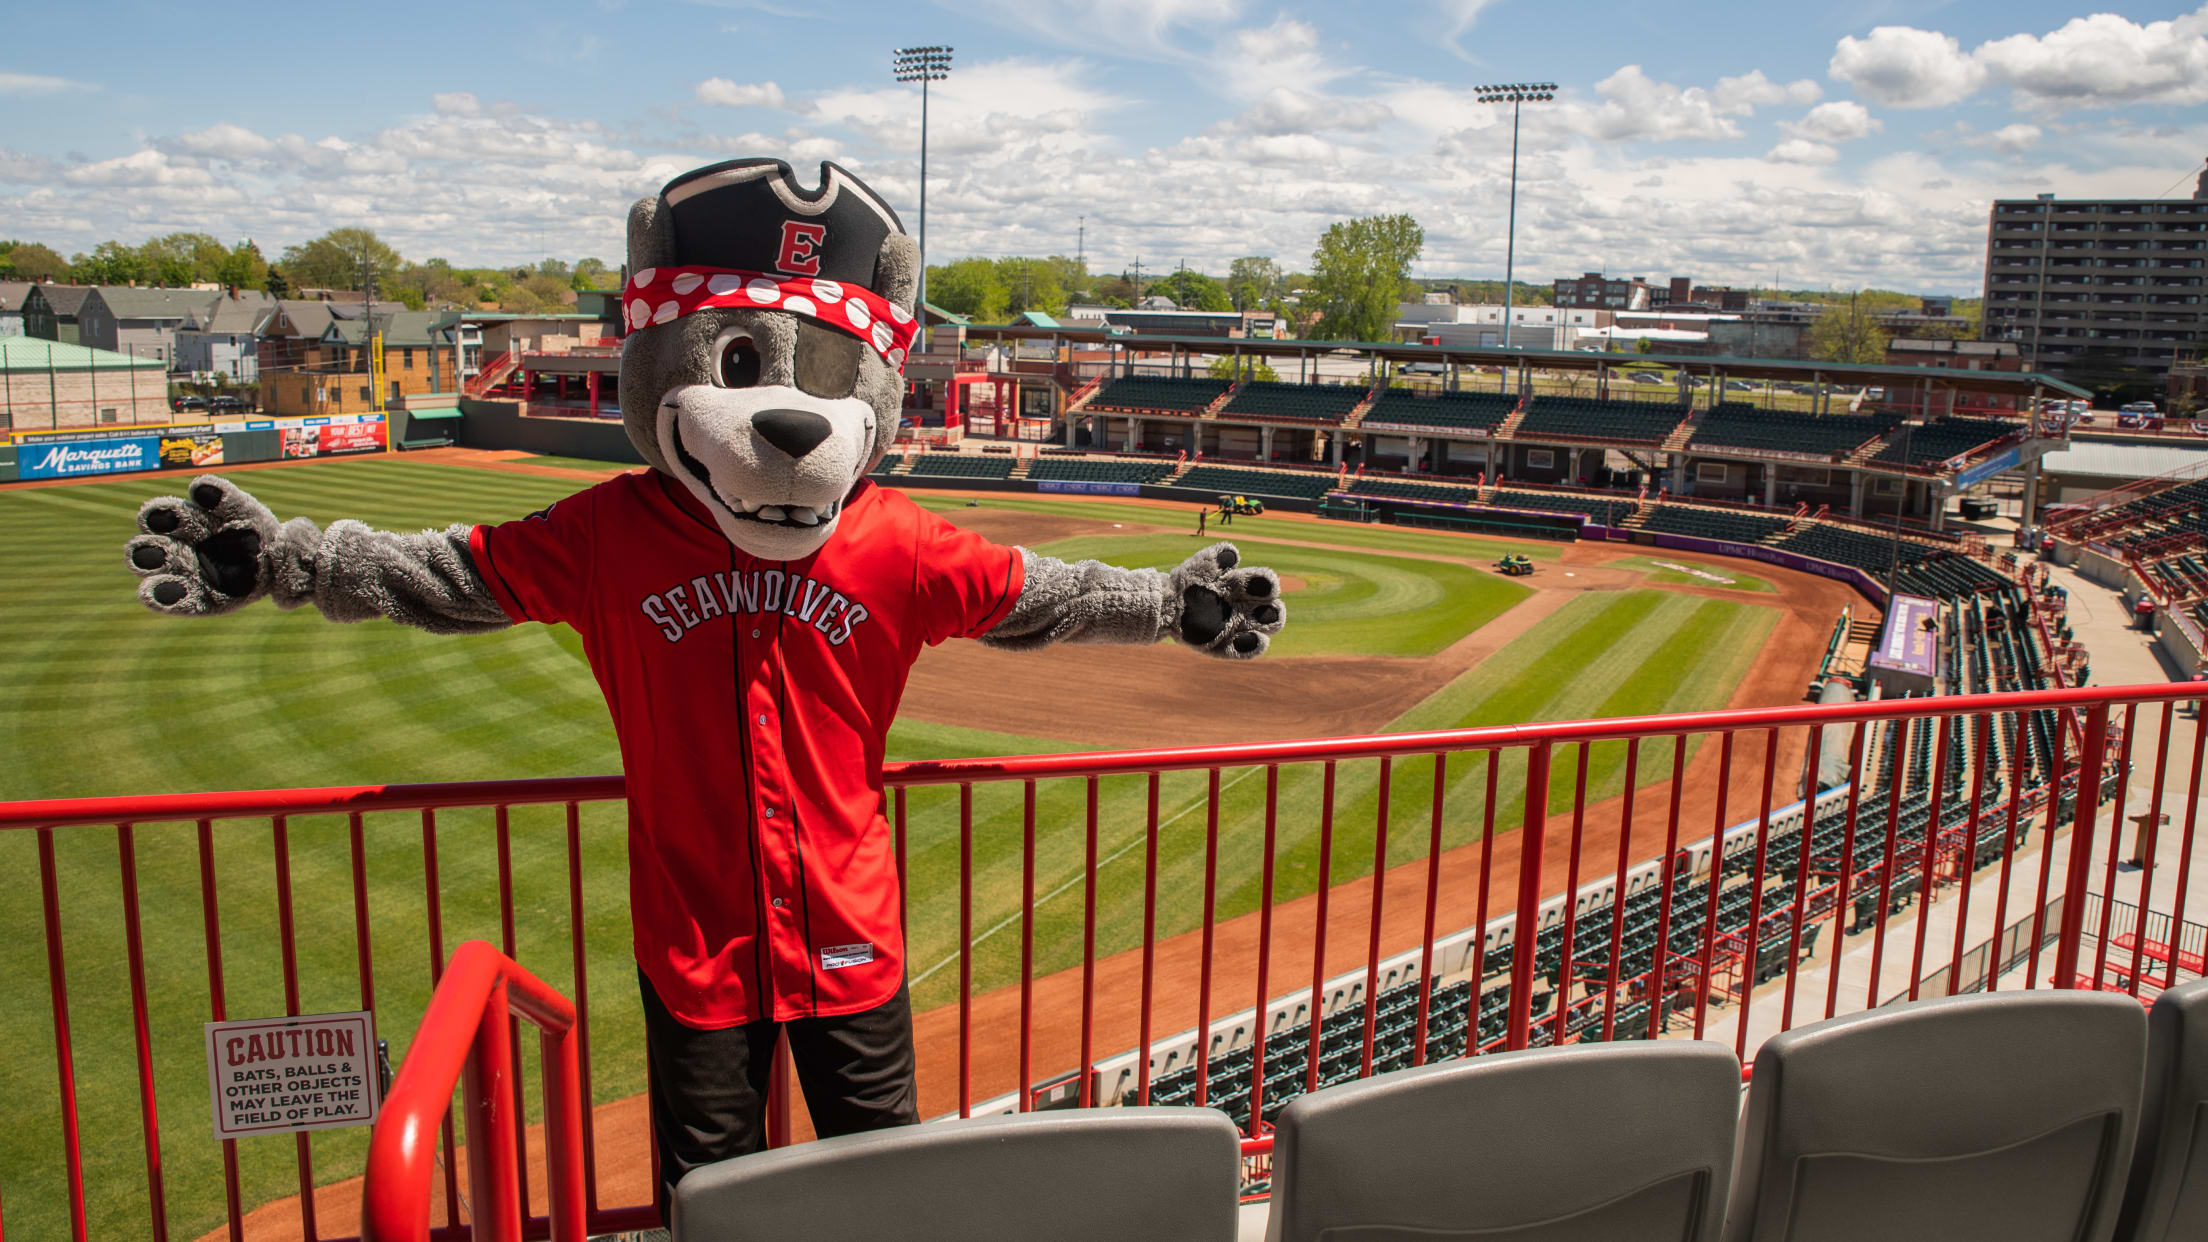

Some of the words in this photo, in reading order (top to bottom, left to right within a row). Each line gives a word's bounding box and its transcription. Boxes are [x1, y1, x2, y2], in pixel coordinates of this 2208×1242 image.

[775, 220, 826, 276] E
[33, 443, 143, 473] Marquette
[68, 461, 111, 472] SAVINGS
[115, 459, 142, 468] BANK
[641, 569, 869, 646] SEAWOLVES
[226, 1028, 355, 1067] CAUTION
[233, 1068, 281, 1082] BATS,
[285, 1063, 337, 1078] BALLS
[341, 1062, 352, 1073] &
[226, 1082, 283, 1097] OTHER
[287, 1075, 362, 1091] OBJECTS
[230, 1098, 266, 1111] MAY
[270, 1092, 324, 1107] LEAVE
[327, 1089, 360, 1101] THE
[234, 1109, 282, 1125] FIELD
[286, 1107, 309, 1120] OF
[313, 1103, 359, 1118] PLAY.
